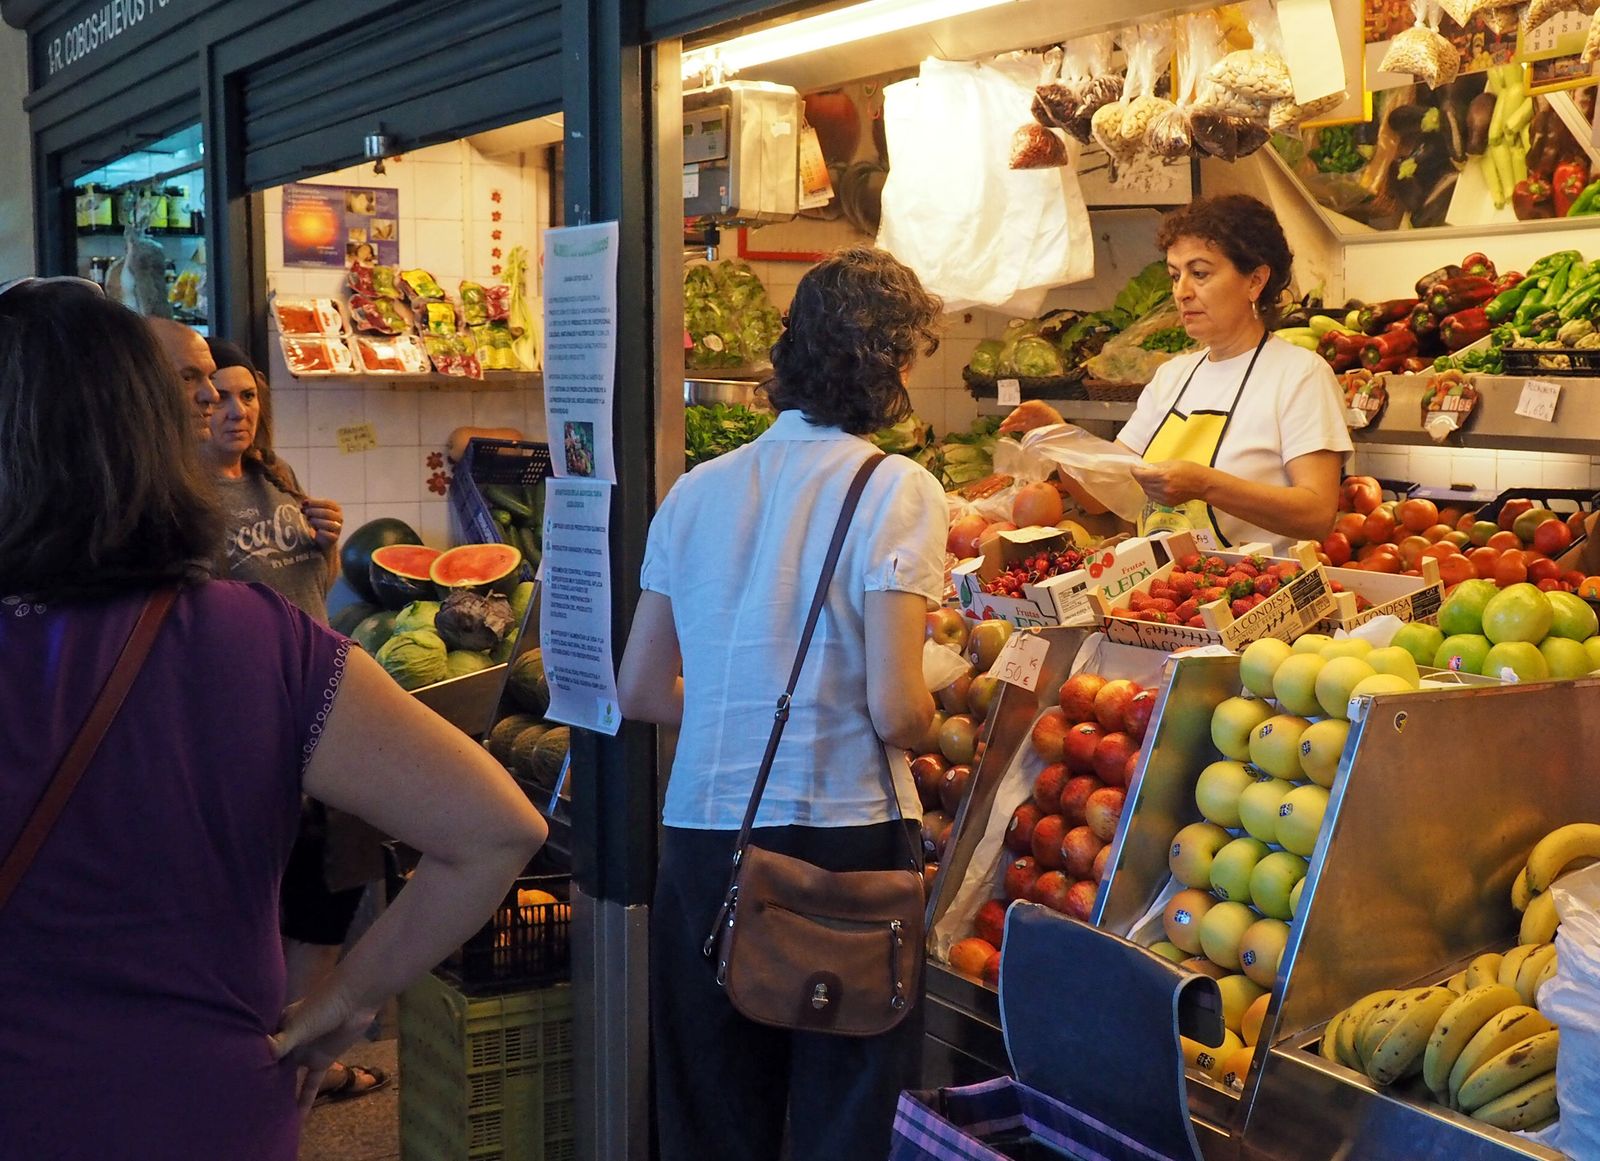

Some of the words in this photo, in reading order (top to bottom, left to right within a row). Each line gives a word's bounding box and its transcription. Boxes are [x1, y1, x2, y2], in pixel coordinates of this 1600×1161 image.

[1121, 560, 1146, 575] Frutas
[1015, 606, 1040, 619] Frutas
[1226, 625, 1241, 642] LA
[1240, 591, 1291, 630] CONDESA
[1348, 619, 1361, 631] LA
[1363, 598, 1411, 623] CONDESA
